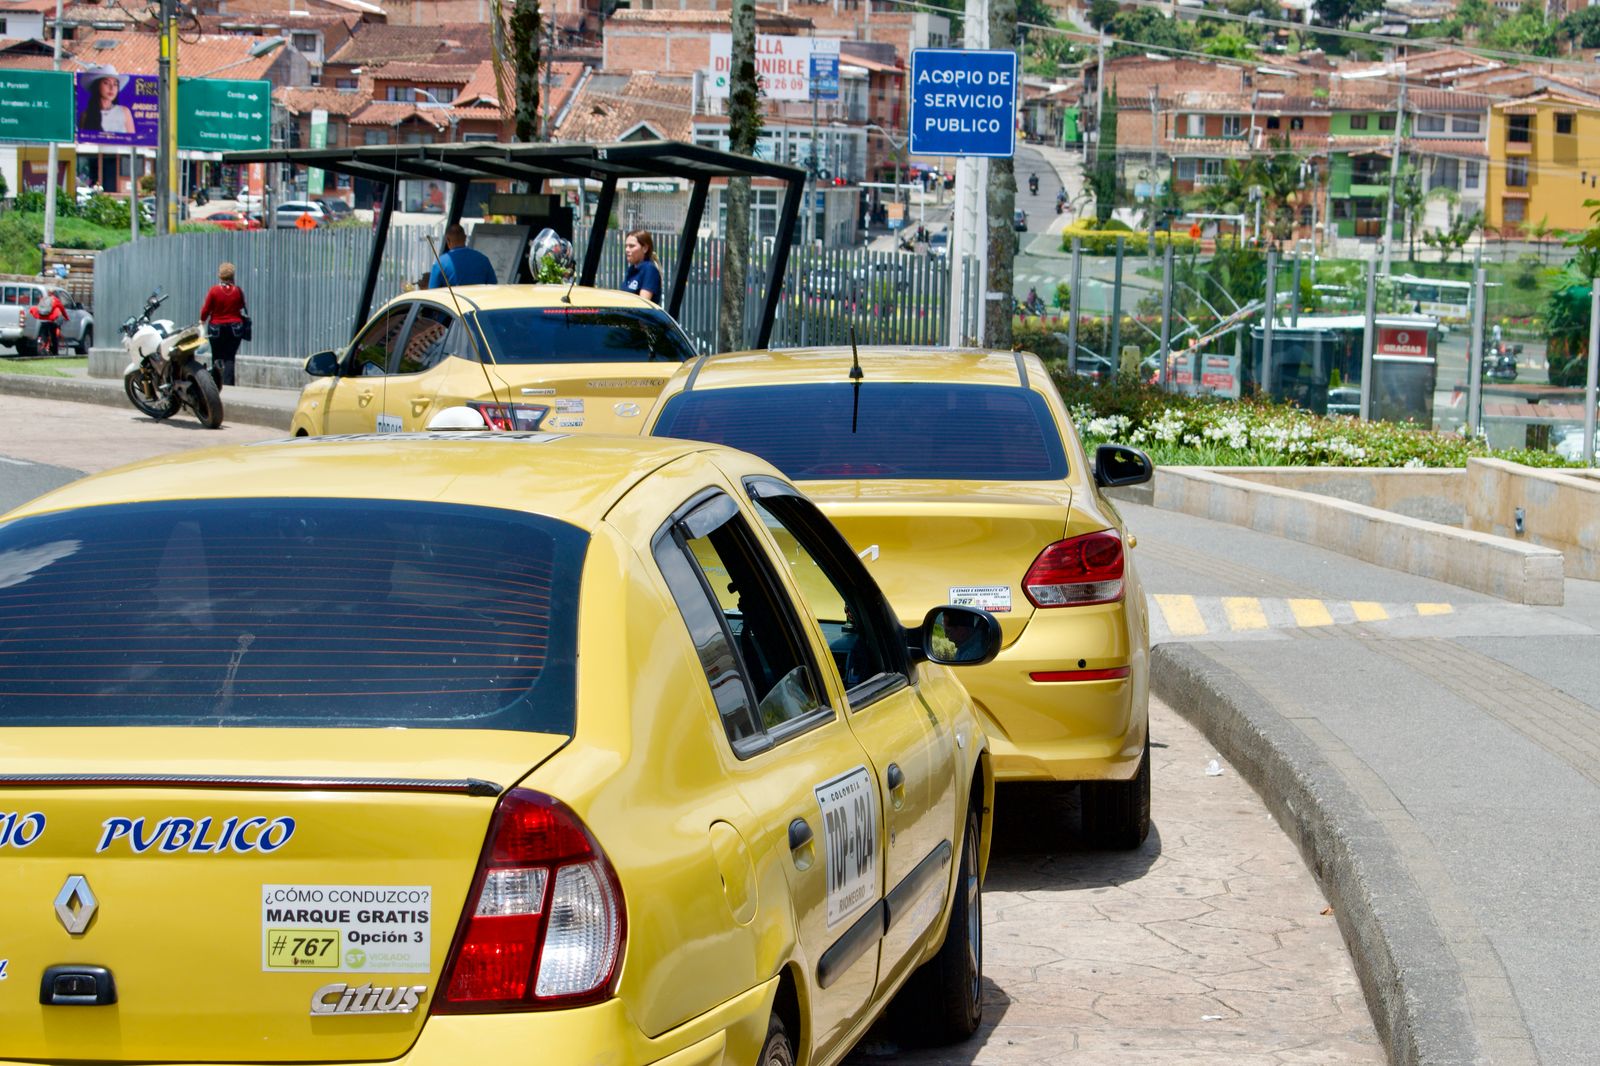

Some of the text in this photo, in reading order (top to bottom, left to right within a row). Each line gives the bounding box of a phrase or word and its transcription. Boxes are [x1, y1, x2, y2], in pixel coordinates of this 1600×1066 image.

[756, 38, 783, 54] LLA
[715, 56, 804, 76] DIONIBLE
[918, 69, 1010, 86] ACOPIO DE
[924, 93, 1004, 109] SERVICIO
[925, 117, 1001, 133] PUBLICO
[1383, 344, 1422, 353] GRACIAS
[830, 781, 861, 802] COLOMBIA
[0, 811, 296, 854] IO PUBLICO
[265, 888, 430, 904] ¿CÓMO CONDUZCO?
[838, 885, 867, 913] RIONEGRO
[266, 909, 429, 924] MARQUE GRATIS
[347, 930, 424, 946] Opción 3
[310, 982, 428, 1015] Citius
